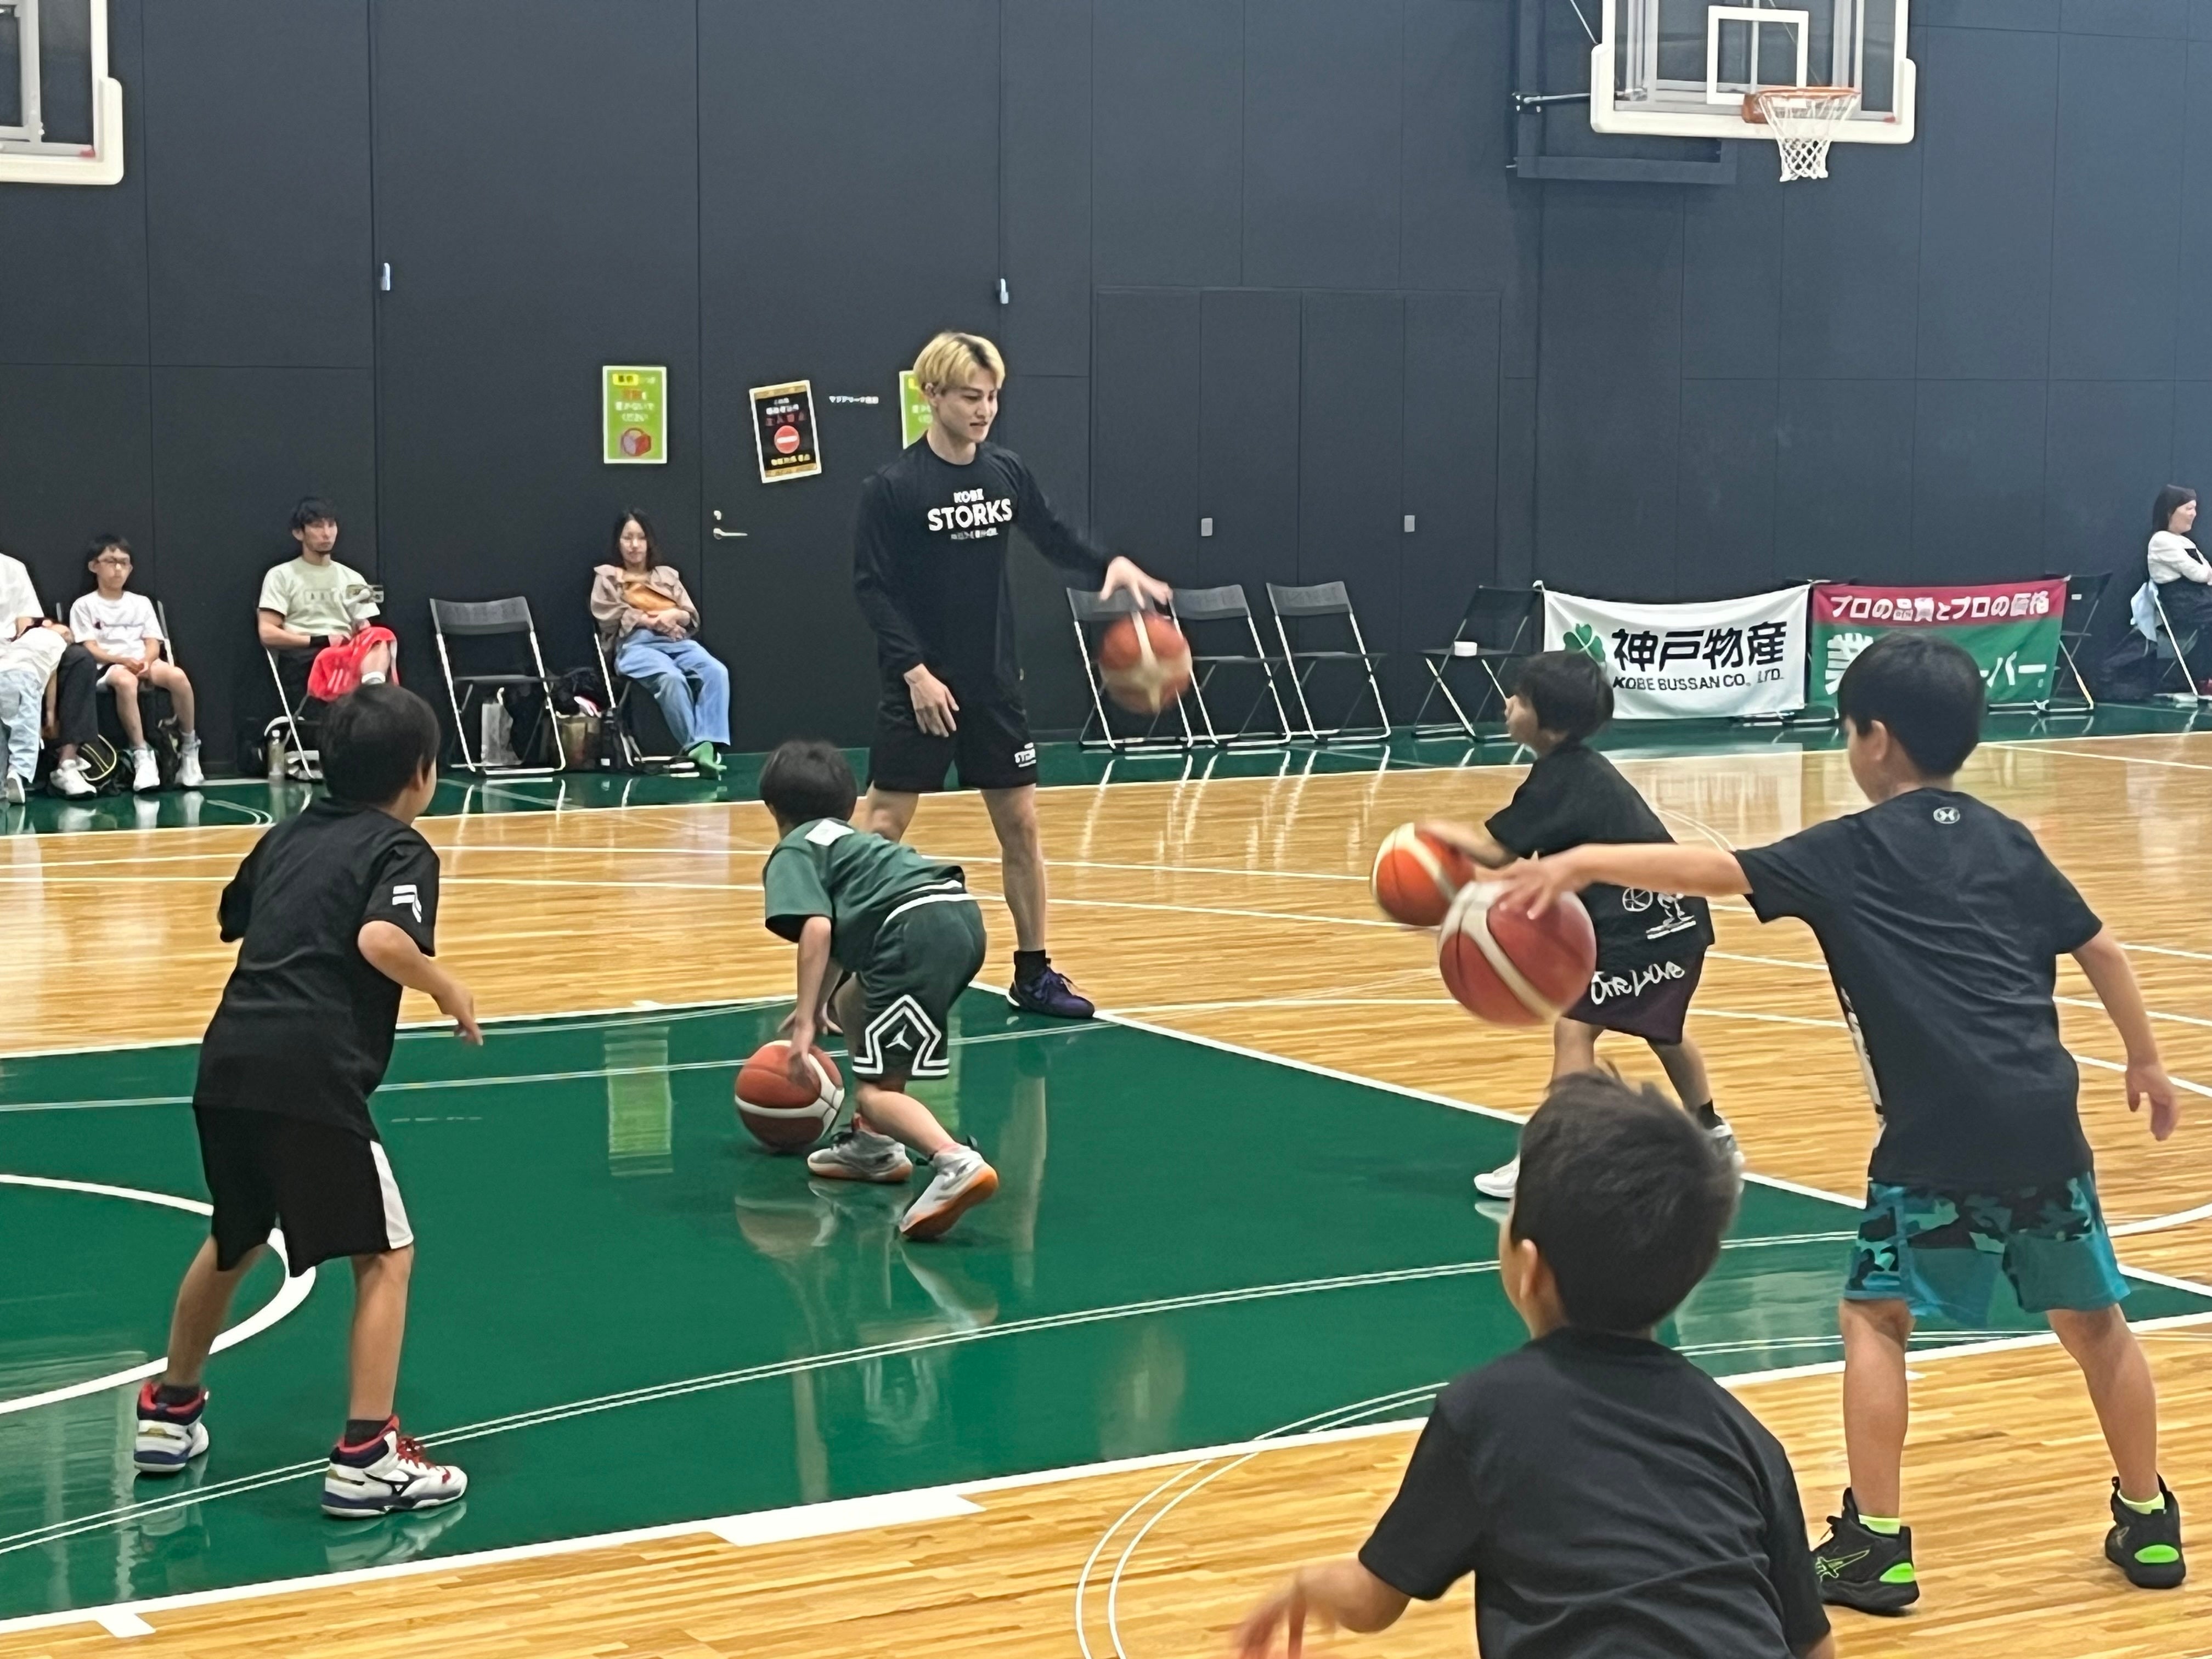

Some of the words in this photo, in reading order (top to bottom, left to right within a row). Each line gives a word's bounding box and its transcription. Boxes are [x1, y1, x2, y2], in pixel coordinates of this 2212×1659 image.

[928, 498, 1012, 531] STORKS
[1611, 621, 1787, 672] 神戸物産
[1613, 676, 1656, 690] KOBE
[1658, 676, 1720, 690] BUSSAN
